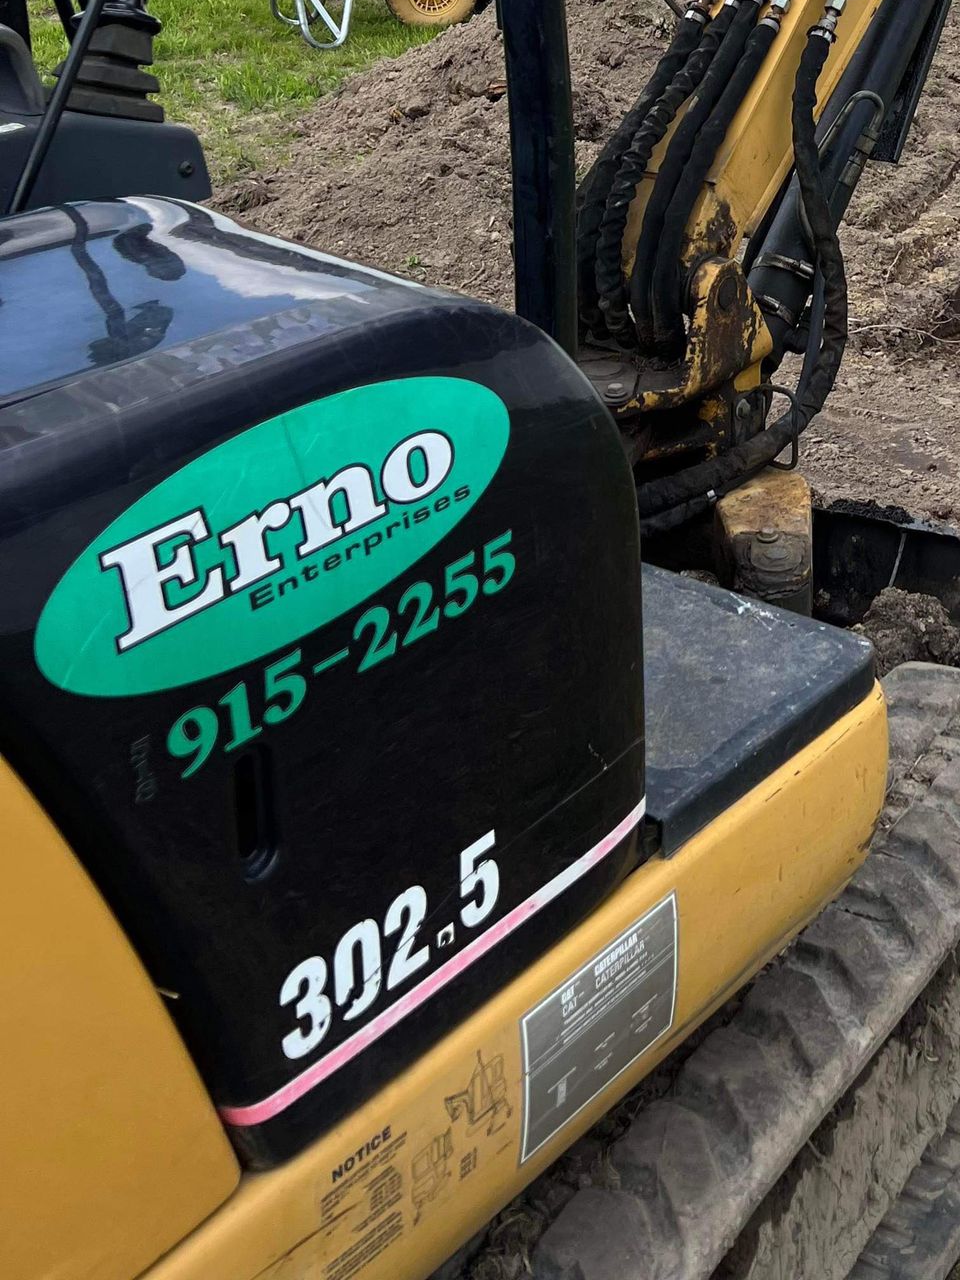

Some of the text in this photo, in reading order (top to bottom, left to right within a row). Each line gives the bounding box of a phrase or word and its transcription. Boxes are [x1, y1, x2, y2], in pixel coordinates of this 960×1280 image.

[101, 429, 455, 653] Erno
[249, 484, 471, 612] Enterprises
[166, 529, 516, 779] 915-2255
[280, 829, 500, 1060] 302.5
[594, 933, 638, 977] CATERPILLAR
[596, 940, 645, 989] CATERPILLAR
[331, 1124, 393, 1183] NOTICE
